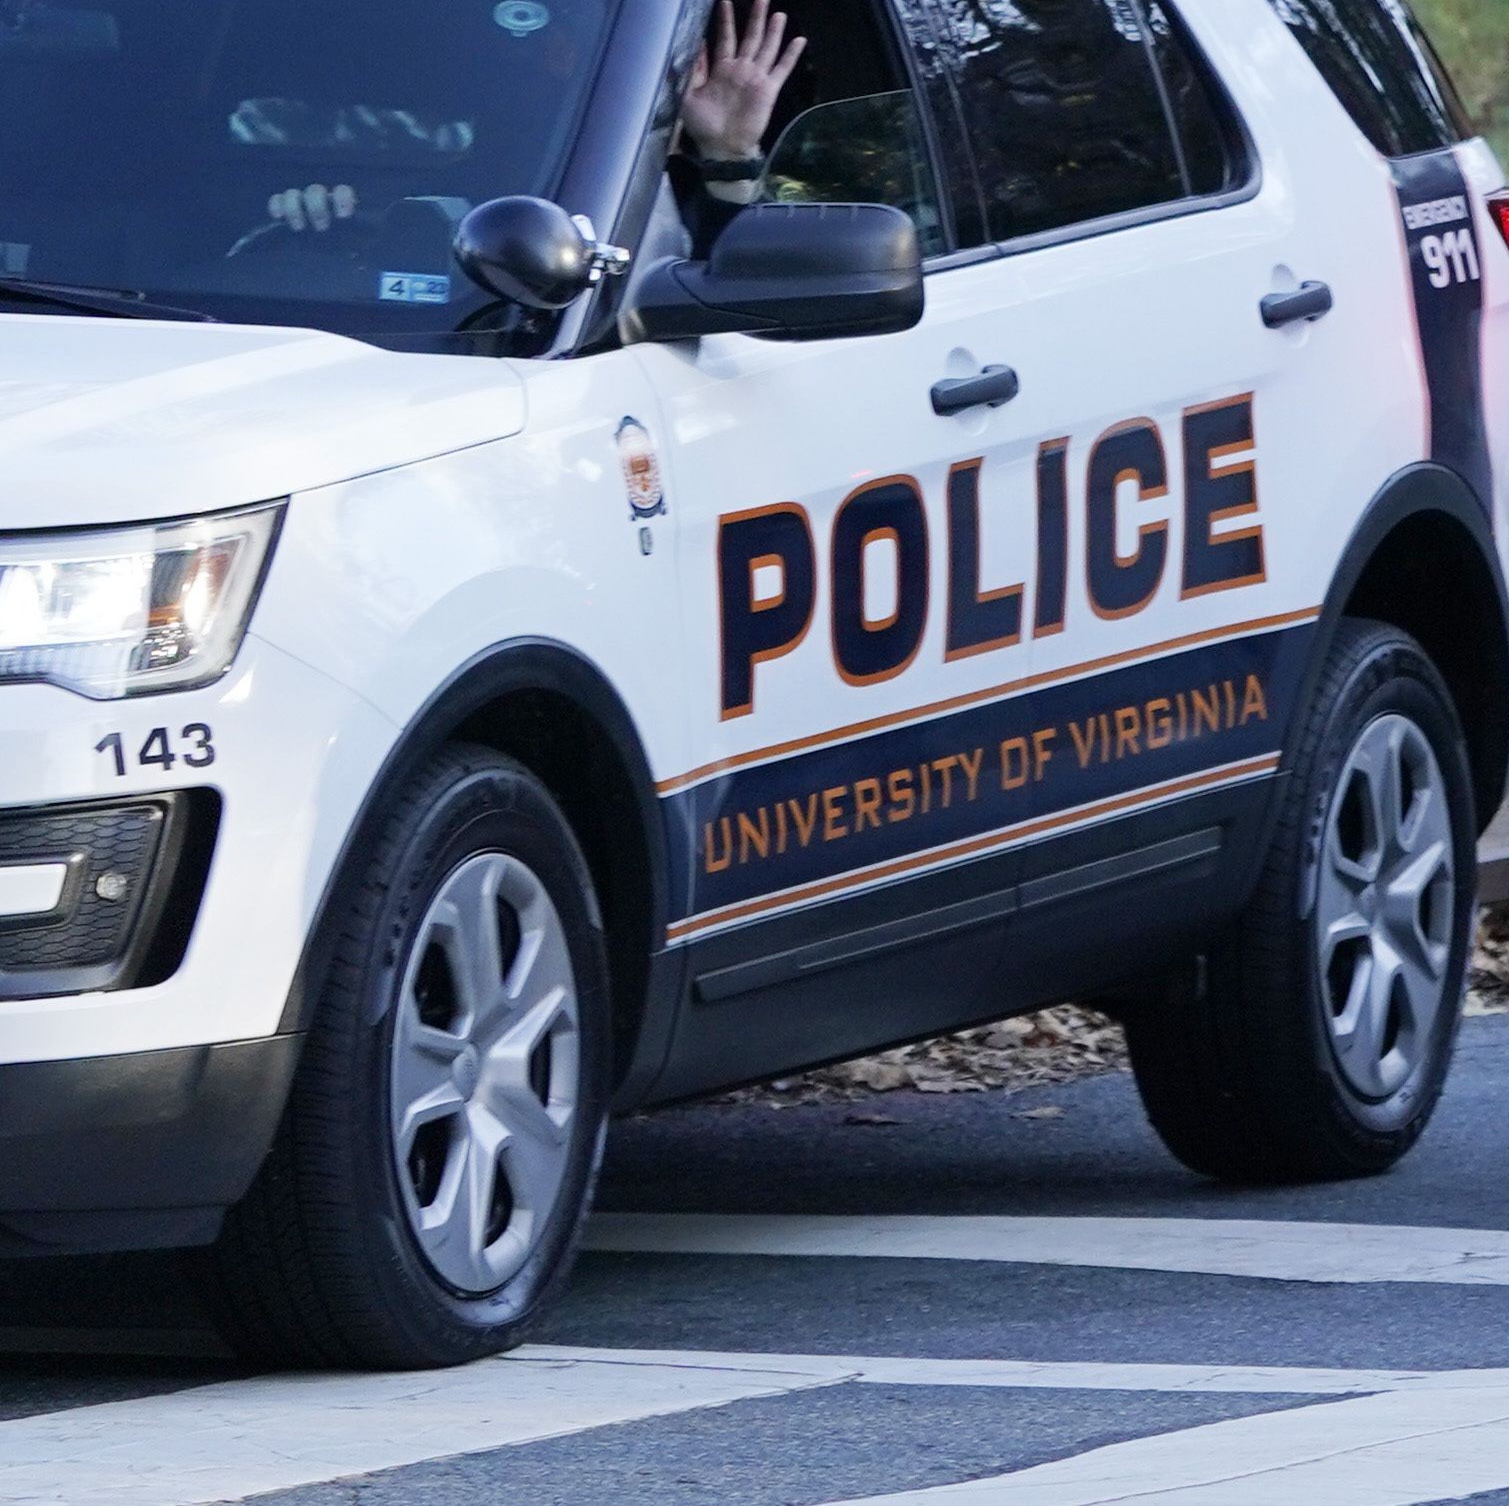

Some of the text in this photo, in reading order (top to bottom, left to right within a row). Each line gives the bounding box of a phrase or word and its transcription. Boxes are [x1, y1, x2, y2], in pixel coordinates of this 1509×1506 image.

[388, 279, 405, 295] 4
[1421, 228, 1480, 289] 911
[716, 390, 1267, 722] POLICE
[93, 722, 215, 776] 143
[703, 674, 1268, 874] UNIVERSITY OF VIRGINIA
